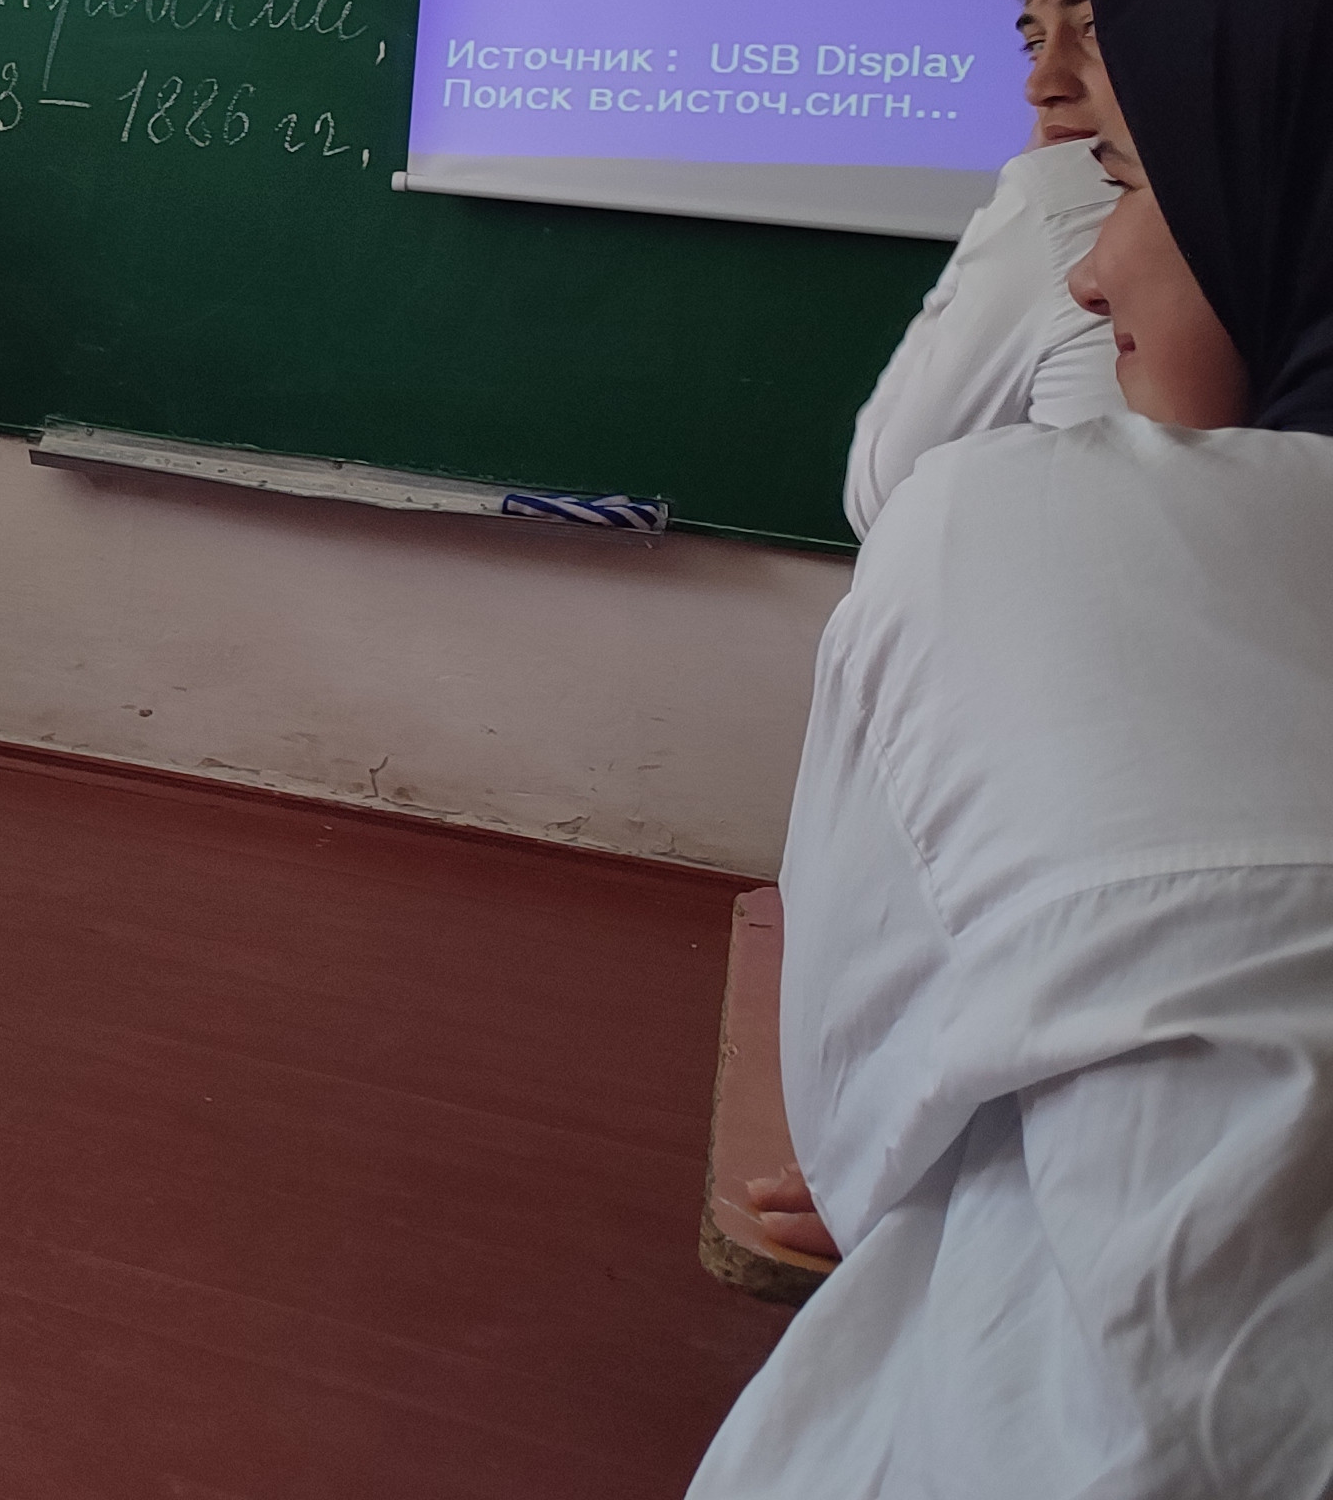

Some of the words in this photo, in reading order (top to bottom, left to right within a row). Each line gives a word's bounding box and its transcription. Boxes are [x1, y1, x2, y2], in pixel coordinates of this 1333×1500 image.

[446, 39, 653, 72] Источник
[710, 43, 800, 75] USB
[816, 43, 975, 84] Display
[442, 78, 573, 111] Поиск
